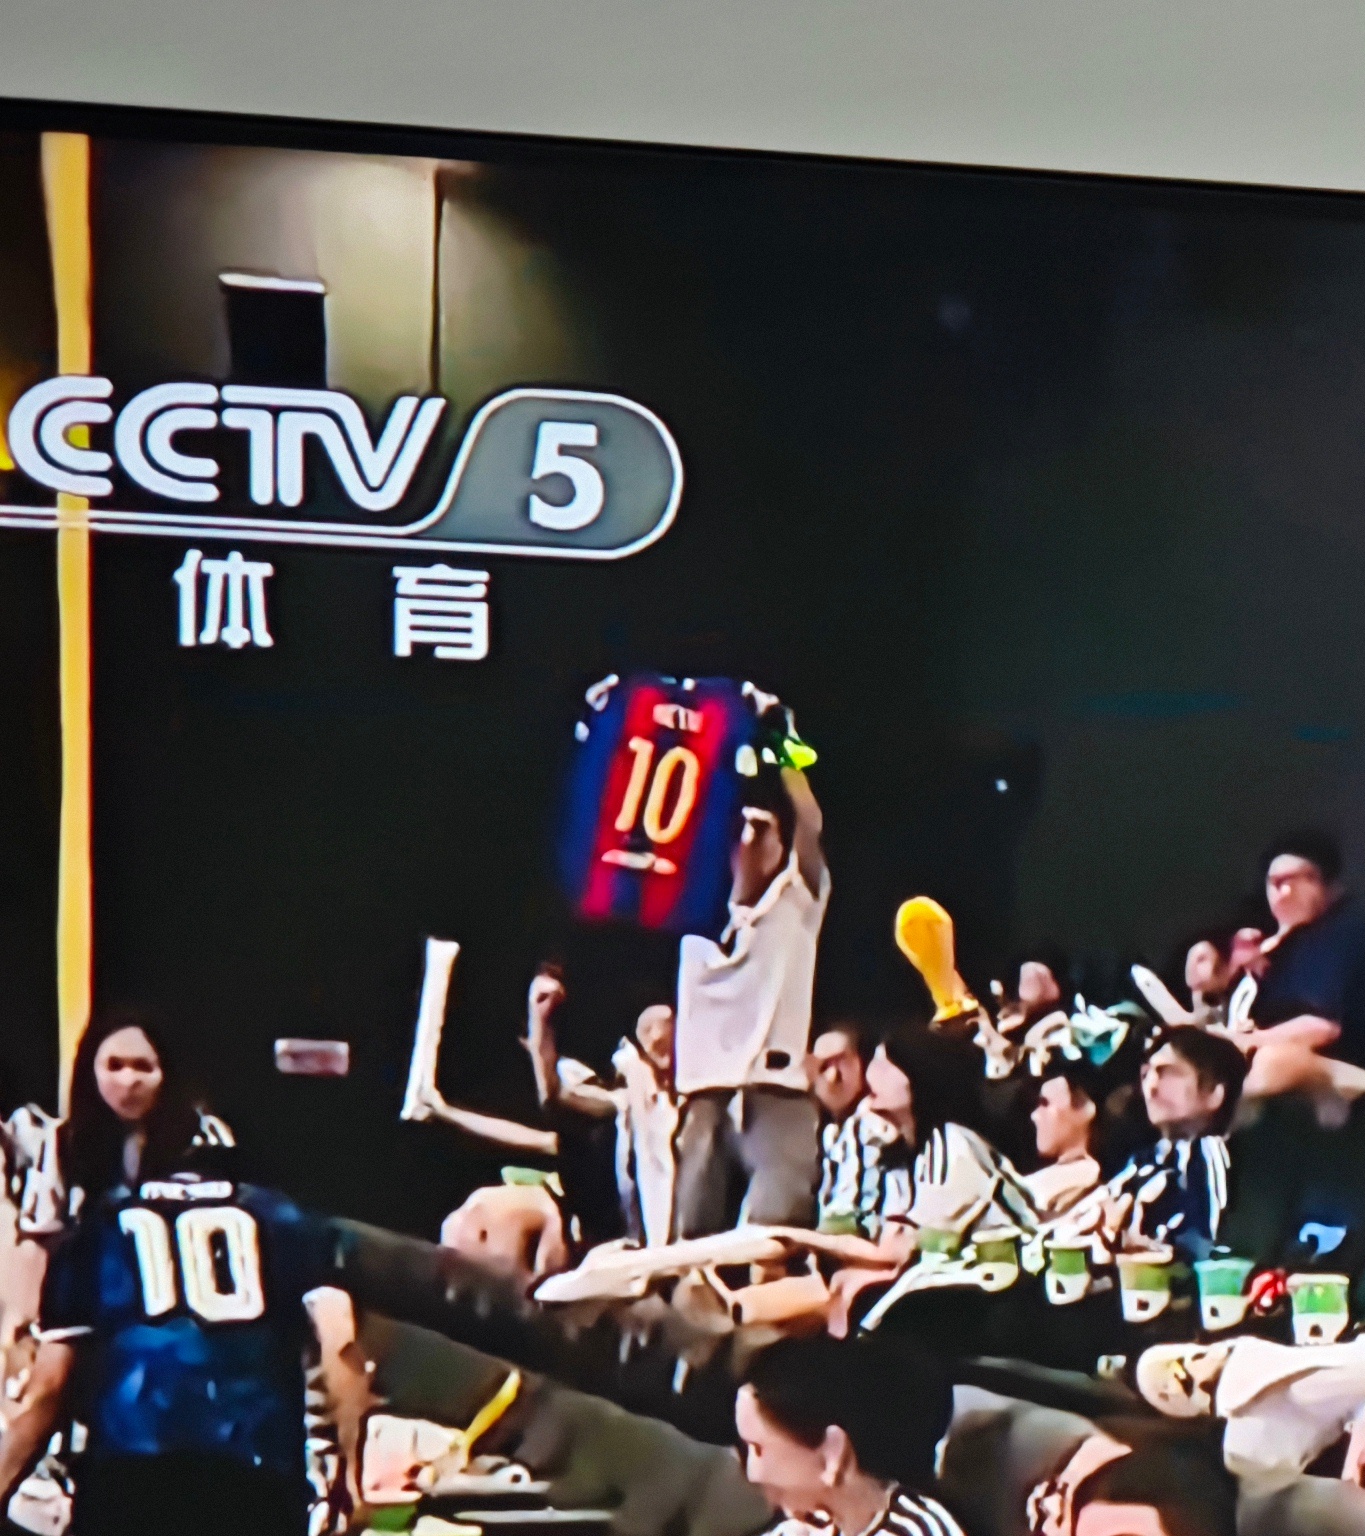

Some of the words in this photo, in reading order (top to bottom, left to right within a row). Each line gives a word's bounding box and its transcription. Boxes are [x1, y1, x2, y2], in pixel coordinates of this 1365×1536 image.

[8, 376, 447, 511] CCTV
[529, 421, 604, 531] 5
[173, 549, 490, 660] 体育
[614, 735, 700, 844] 10
[118, 1206, 265, 1322] 10
